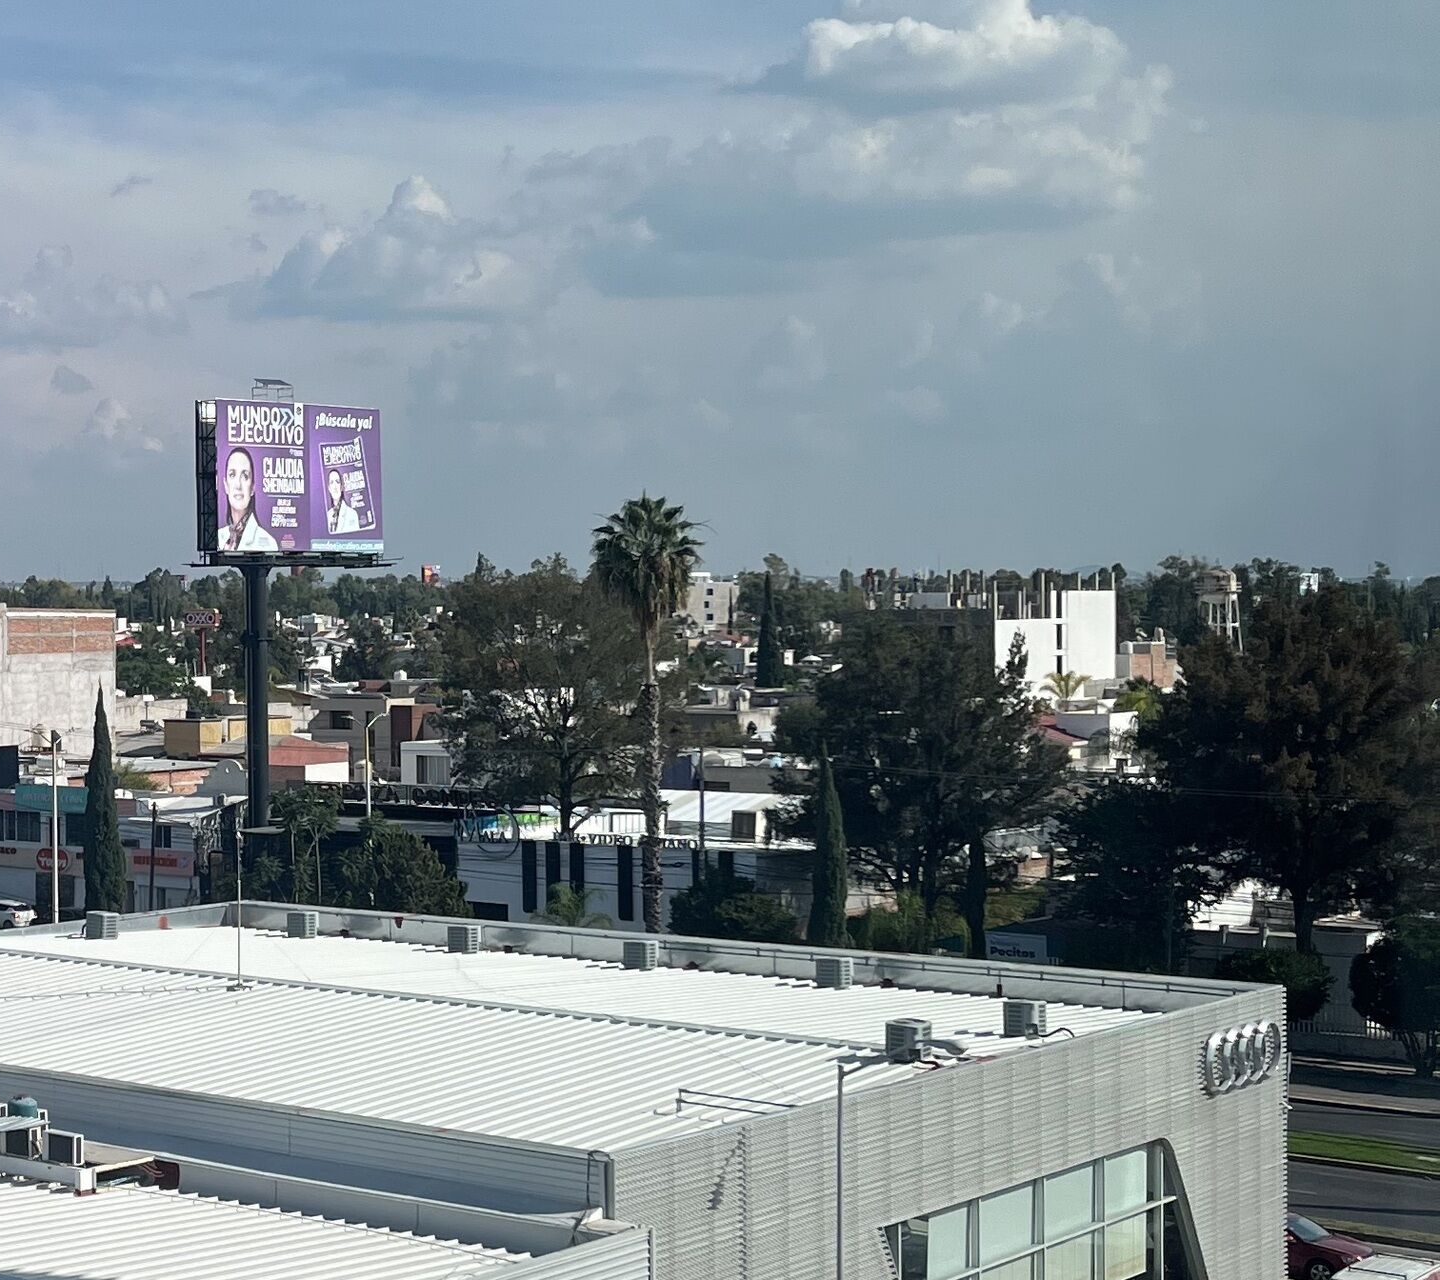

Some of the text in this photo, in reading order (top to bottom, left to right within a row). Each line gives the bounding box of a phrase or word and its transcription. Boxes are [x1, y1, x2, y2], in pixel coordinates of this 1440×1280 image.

[227, 405, 281, 426] MUNDO
[314, 412, 374, 432] ¡Búscala ya!
[227, 423, 304, 445] EJECUTIVO
[262, 457, 304, 479] CLAUDIA
[186, 611, 215, 624] OXXO
[588, 833, 633, 847] VIDEO
